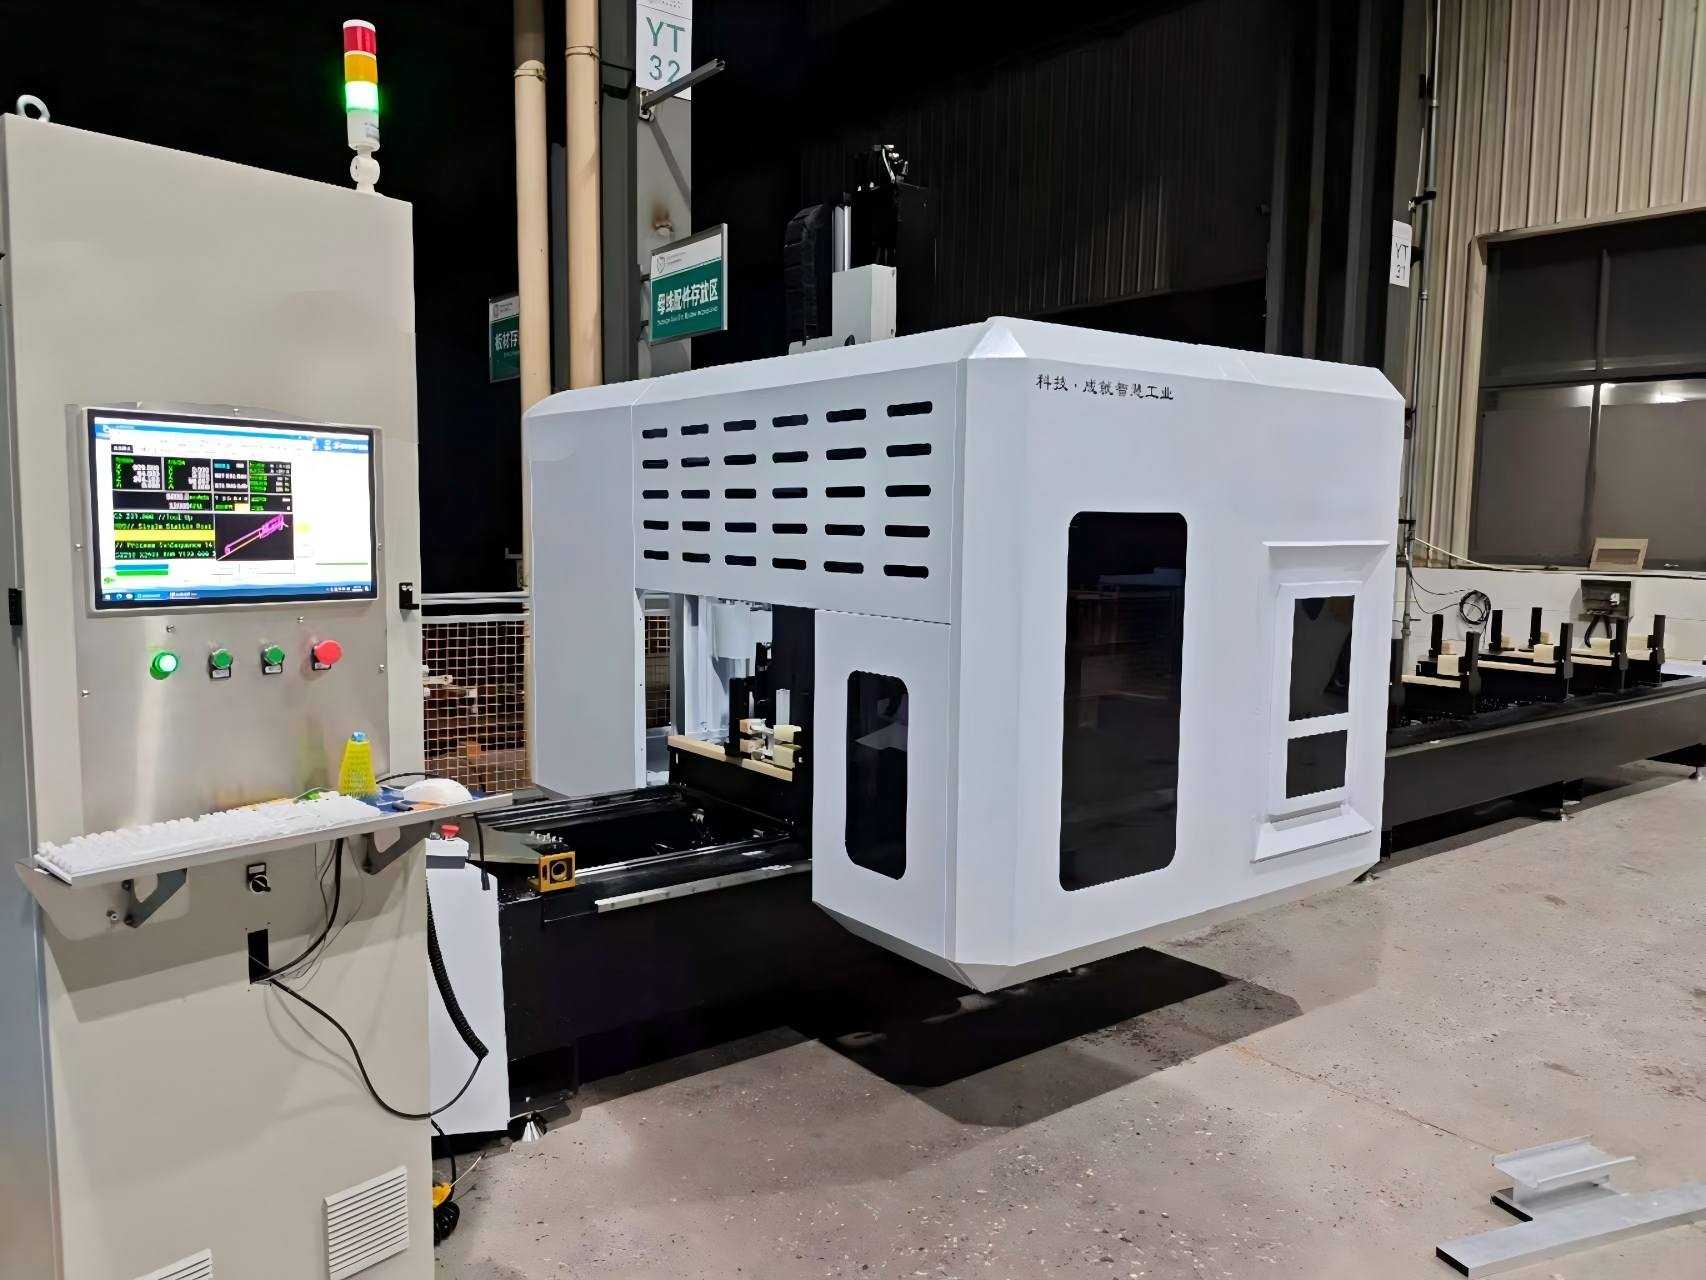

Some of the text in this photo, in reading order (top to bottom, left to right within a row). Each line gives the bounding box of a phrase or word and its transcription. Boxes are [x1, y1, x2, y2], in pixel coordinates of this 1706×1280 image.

[646, 16, 686, 53] YT
[649, 54, 681, 83] 32
[1396, 242, 1409, 261] YT
